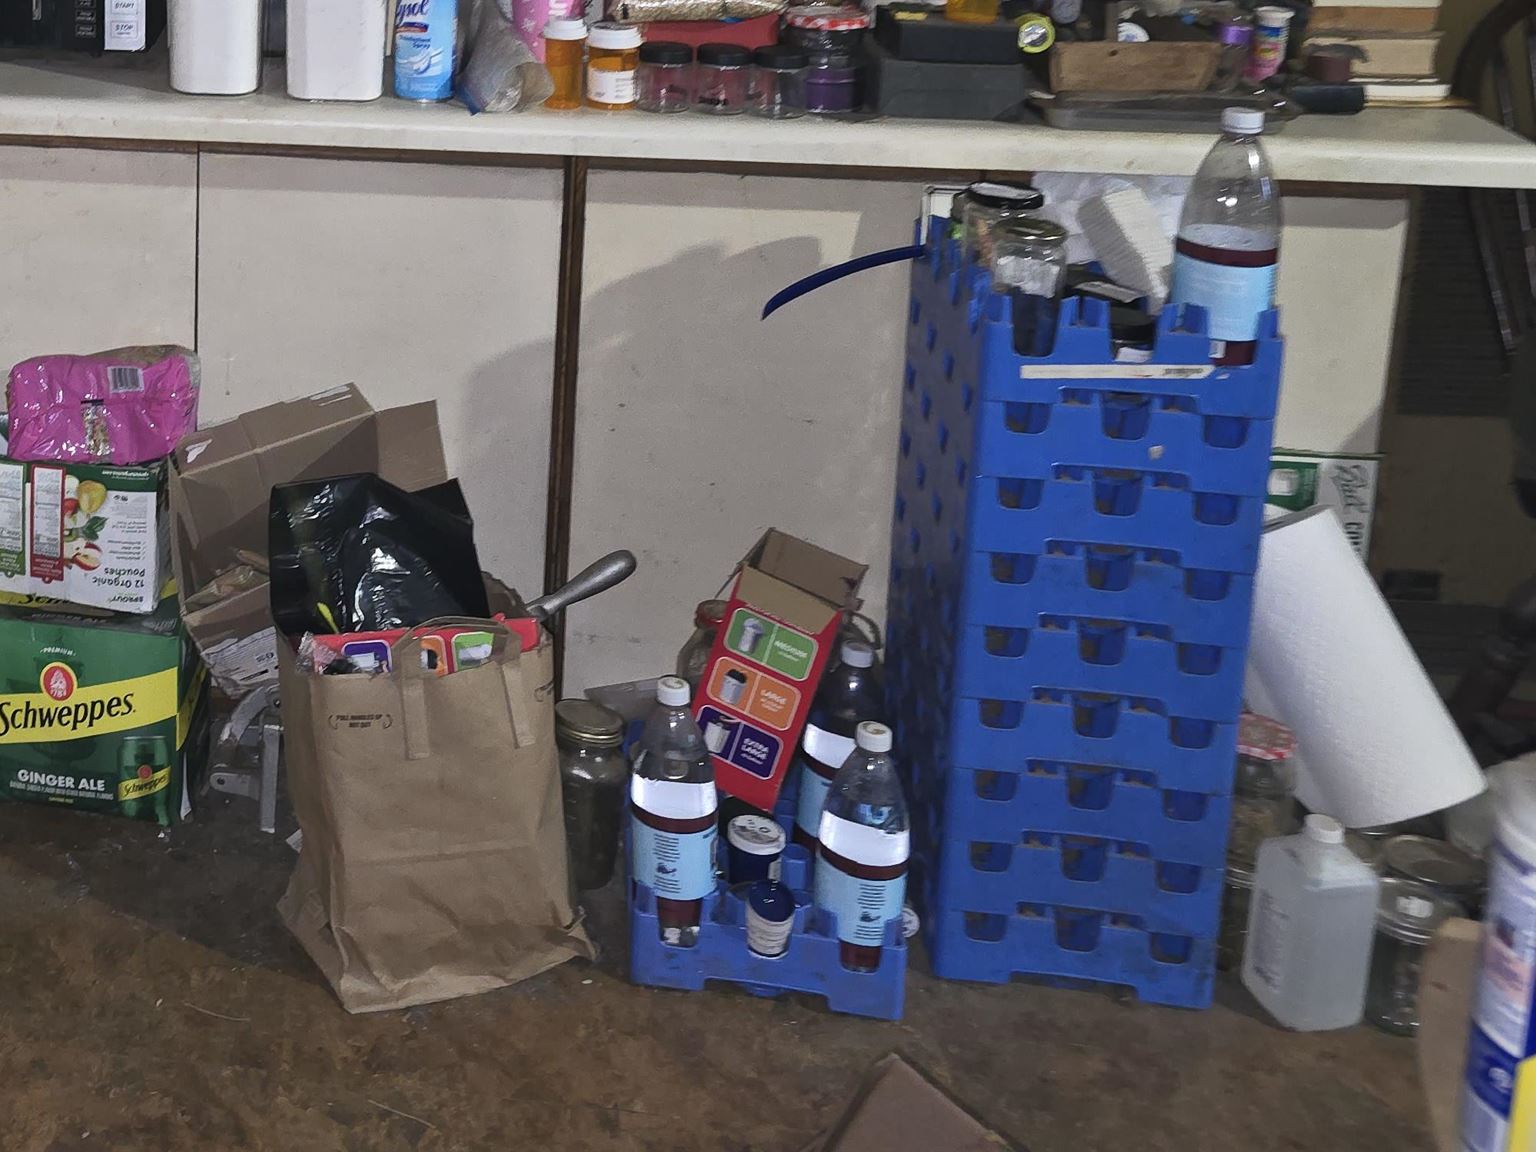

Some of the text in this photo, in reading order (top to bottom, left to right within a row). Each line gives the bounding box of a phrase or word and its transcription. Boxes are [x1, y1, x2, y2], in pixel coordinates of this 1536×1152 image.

[104, 567, 146, 577] Pouches
[91, 576, 146, 589] 12 Organic
[760, 689, 787, 705] LARGE
[17, 769, 77, 788] GINGER
[78, 776, 106, 792] ALE
